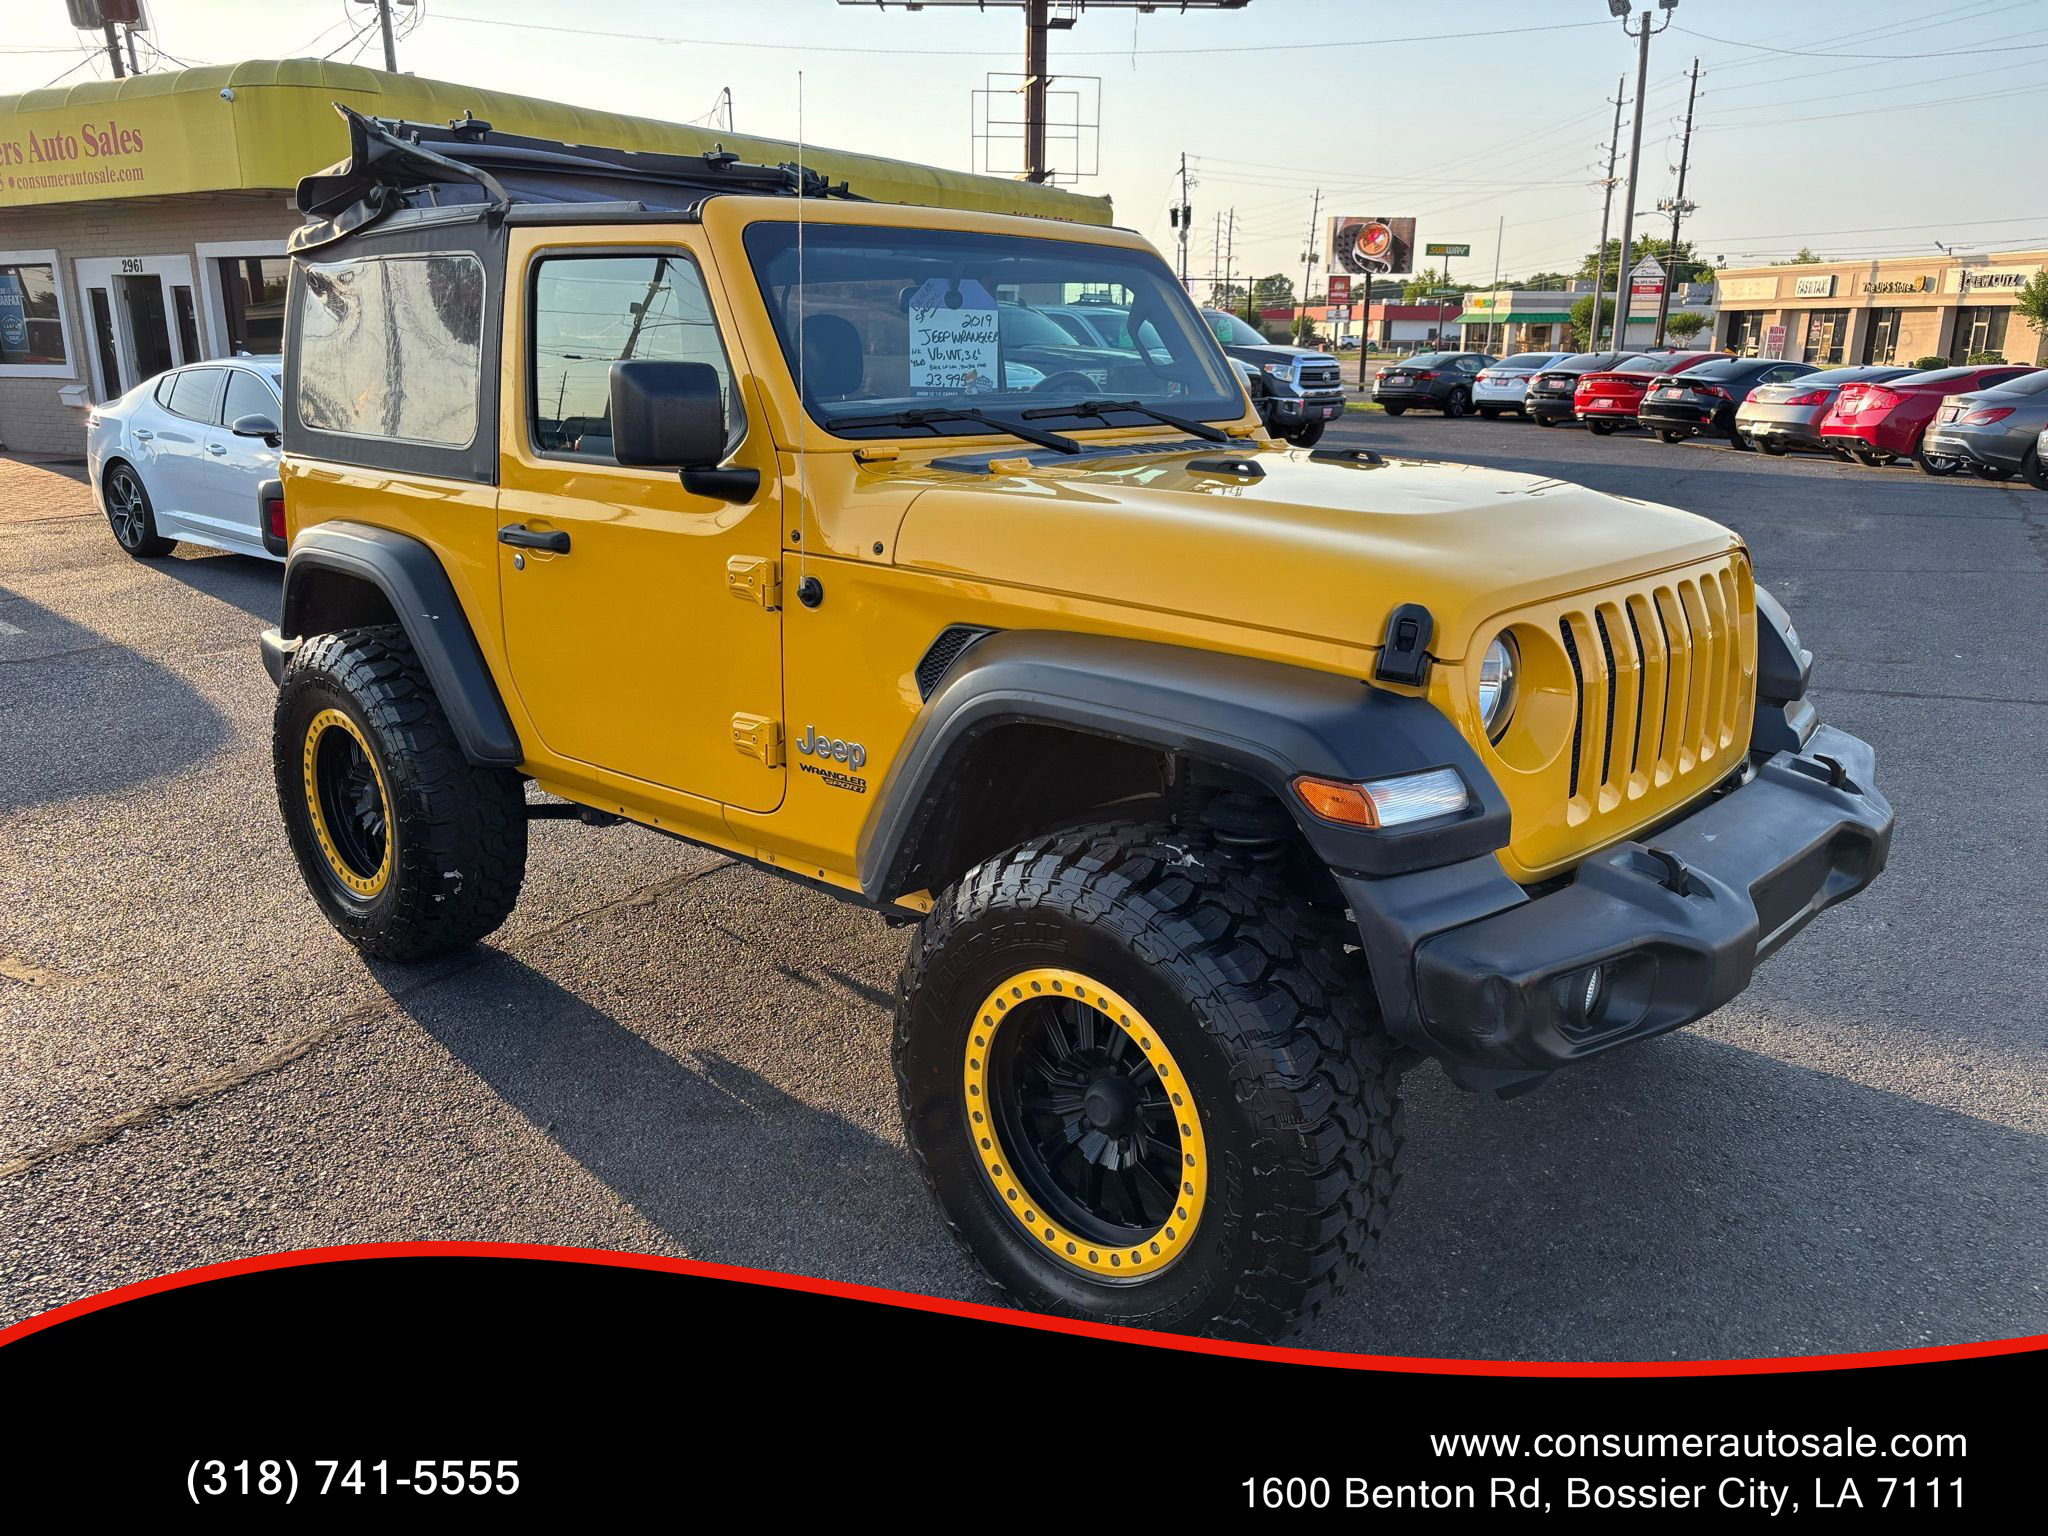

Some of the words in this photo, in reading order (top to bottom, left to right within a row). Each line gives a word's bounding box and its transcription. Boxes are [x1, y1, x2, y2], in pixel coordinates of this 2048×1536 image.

[0, 142, 23, 166] rs
[29, 130, 78, 163] Auto
[82, 121, 144, 158] Sales
[17, 166, 144, 190] consumerautosale.com
[1430, 246, 1468, 255] SUBWAY
[122, 259, 143, 272] 2961
[1876, 282, 1893, 293] UPS
[1894, 281, 1914, 293] Store
[962, 314, 992, 328] 2019
[918, 329, 950, 346] JEEP
[951, 330, 999, 344] WRANGLER
[796, 724, 867, 772] Jeep
[799, 763, 867, 787] WRANGLER
[824, 777, 866, 794] SPORT
